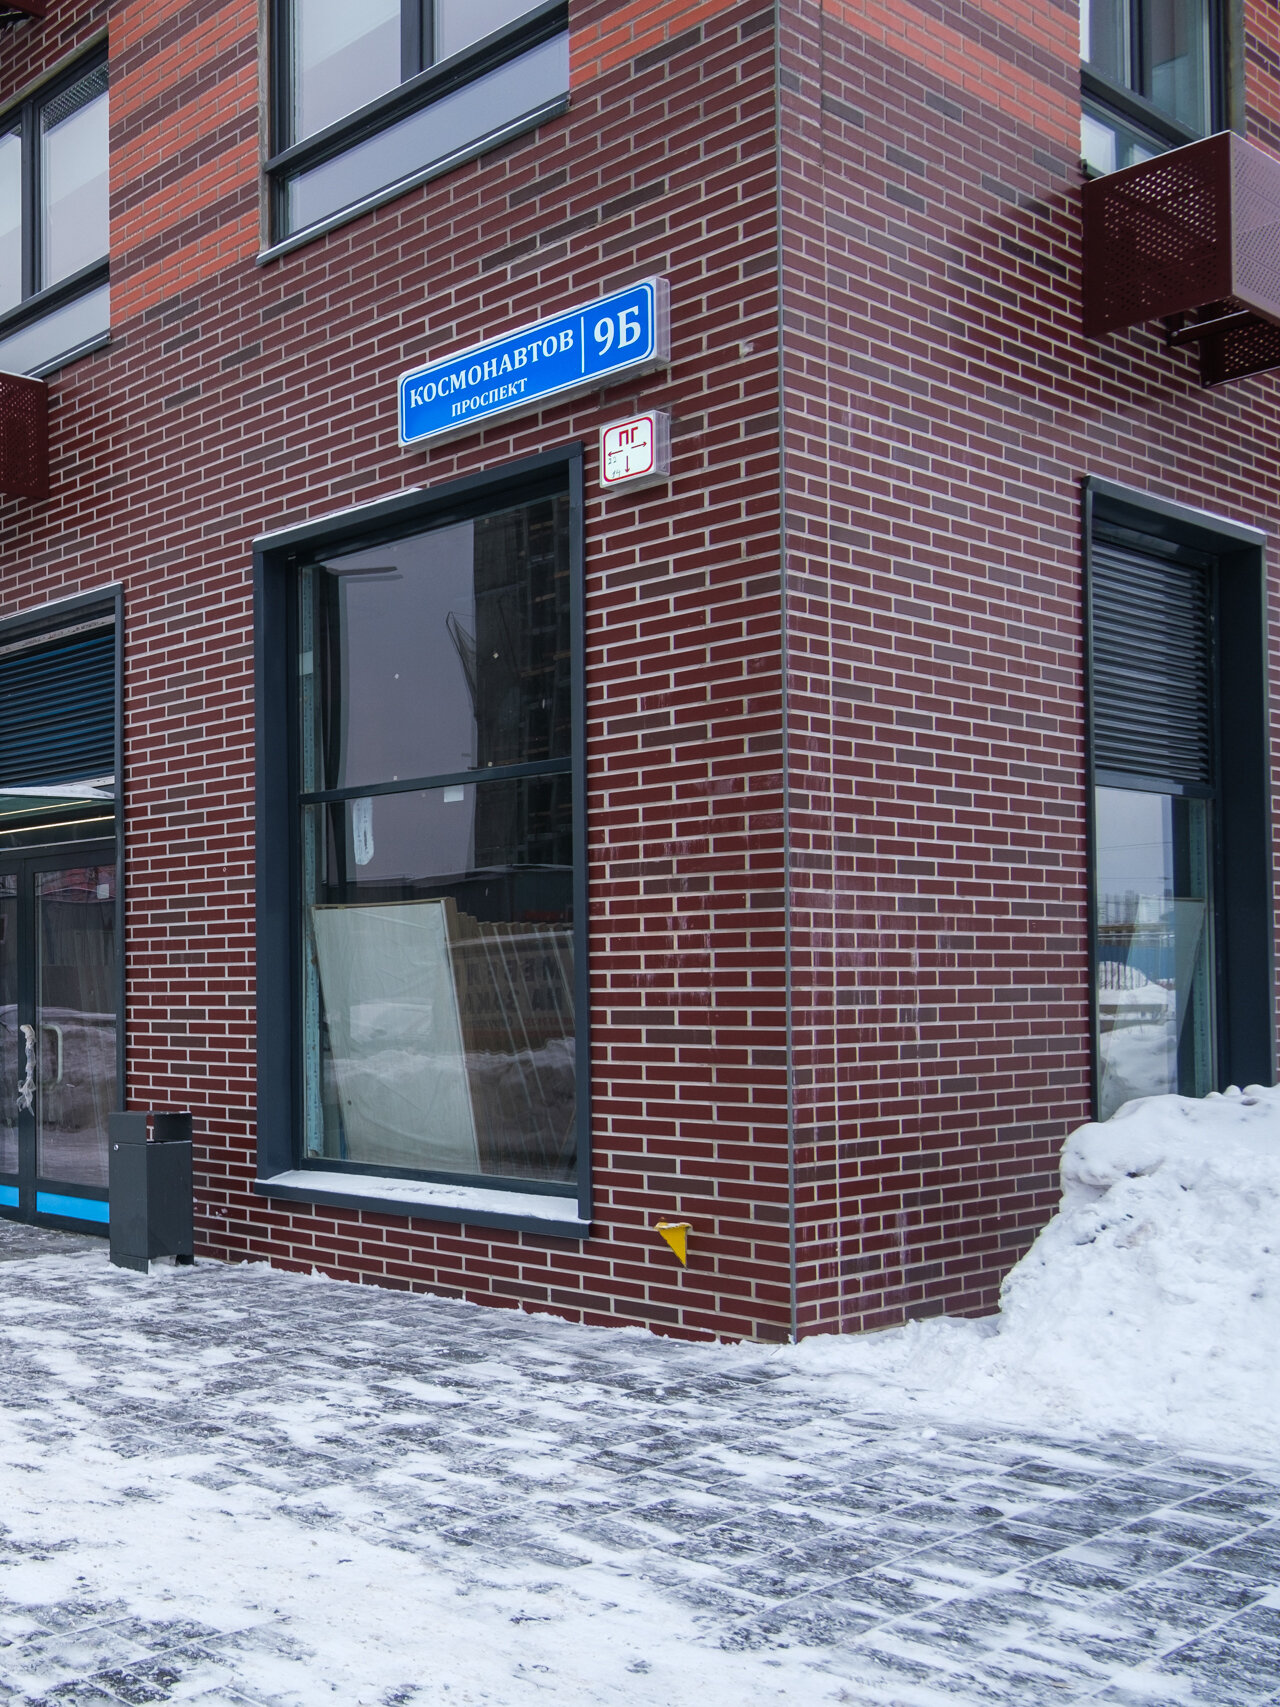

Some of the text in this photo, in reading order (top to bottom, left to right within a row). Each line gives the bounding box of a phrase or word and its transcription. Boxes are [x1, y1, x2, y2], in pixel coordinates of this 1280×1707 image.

[409, 305, 642, 408] КОСМОНАВТОВ 9Б
[451, 377, 528, 418] ПРОСПЕКТ
[618, 426, 639, 447] ПГ
